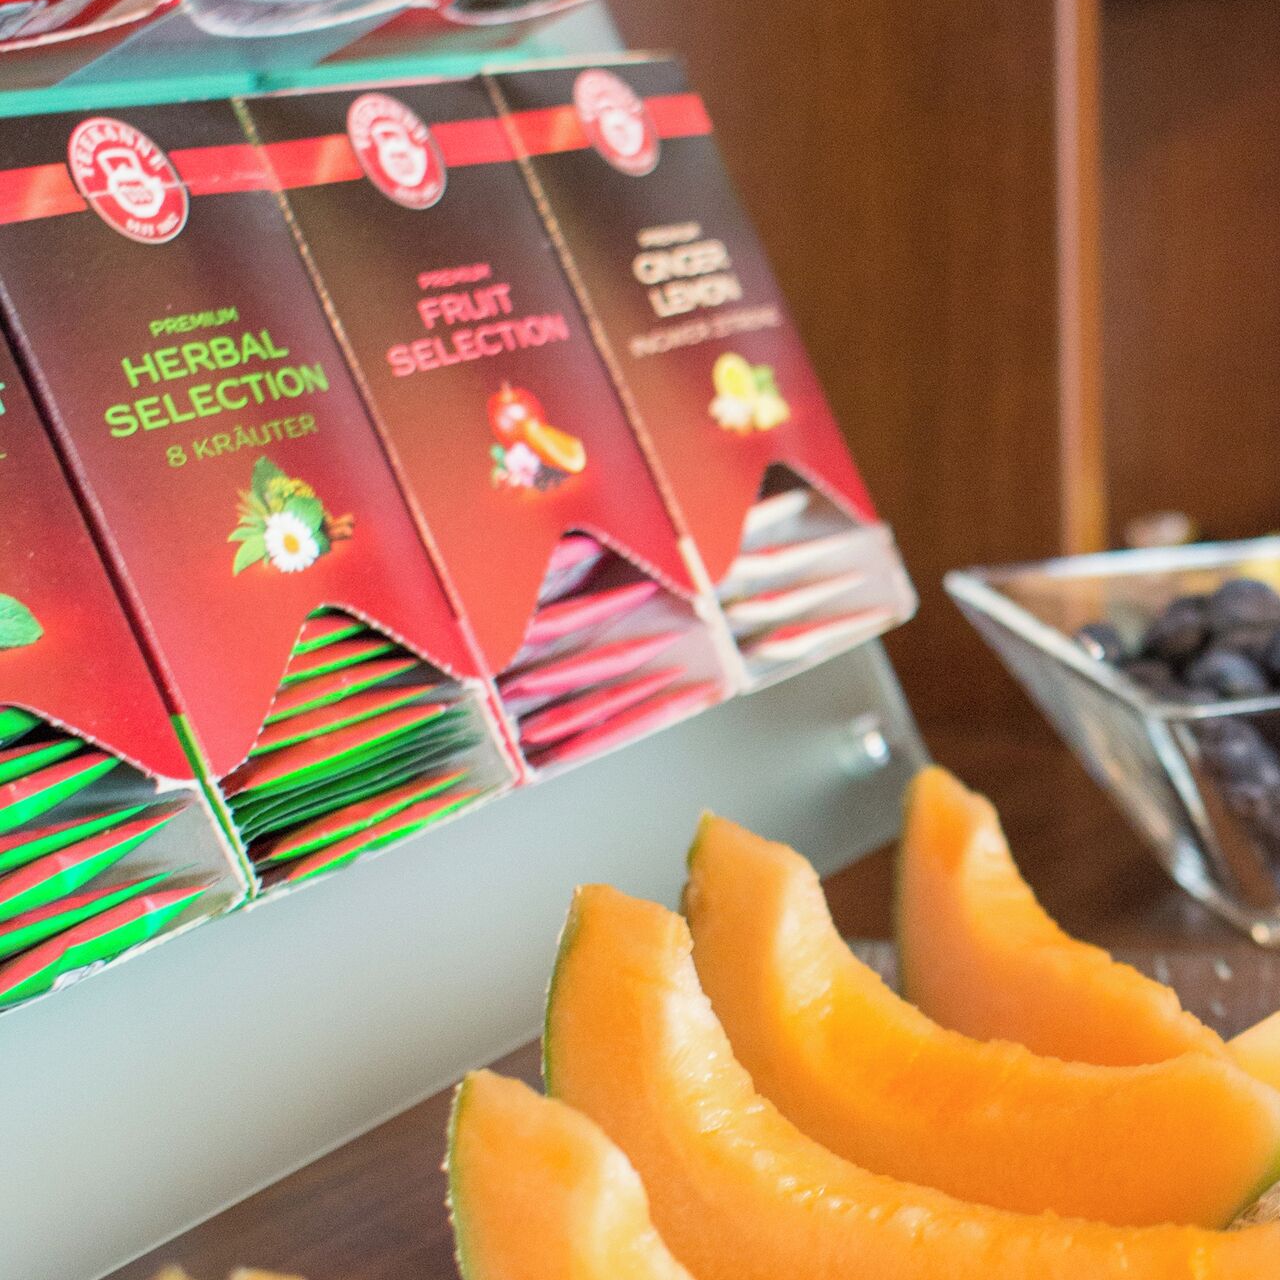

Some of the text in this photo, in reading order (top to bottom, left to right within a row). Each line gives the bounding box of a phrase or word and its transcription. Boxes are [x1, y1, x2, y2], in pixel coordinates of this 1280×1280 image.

[149, 305, 240, 337] PREMIUM
[417, 282, 514, 330] FRUIT
[121, 328, 290, 389] HERBAL
[386, 312, 571, 378] SELECTION
[104, 362, 330, 438] SELECTION
[165, 444, 188, 468] 8
